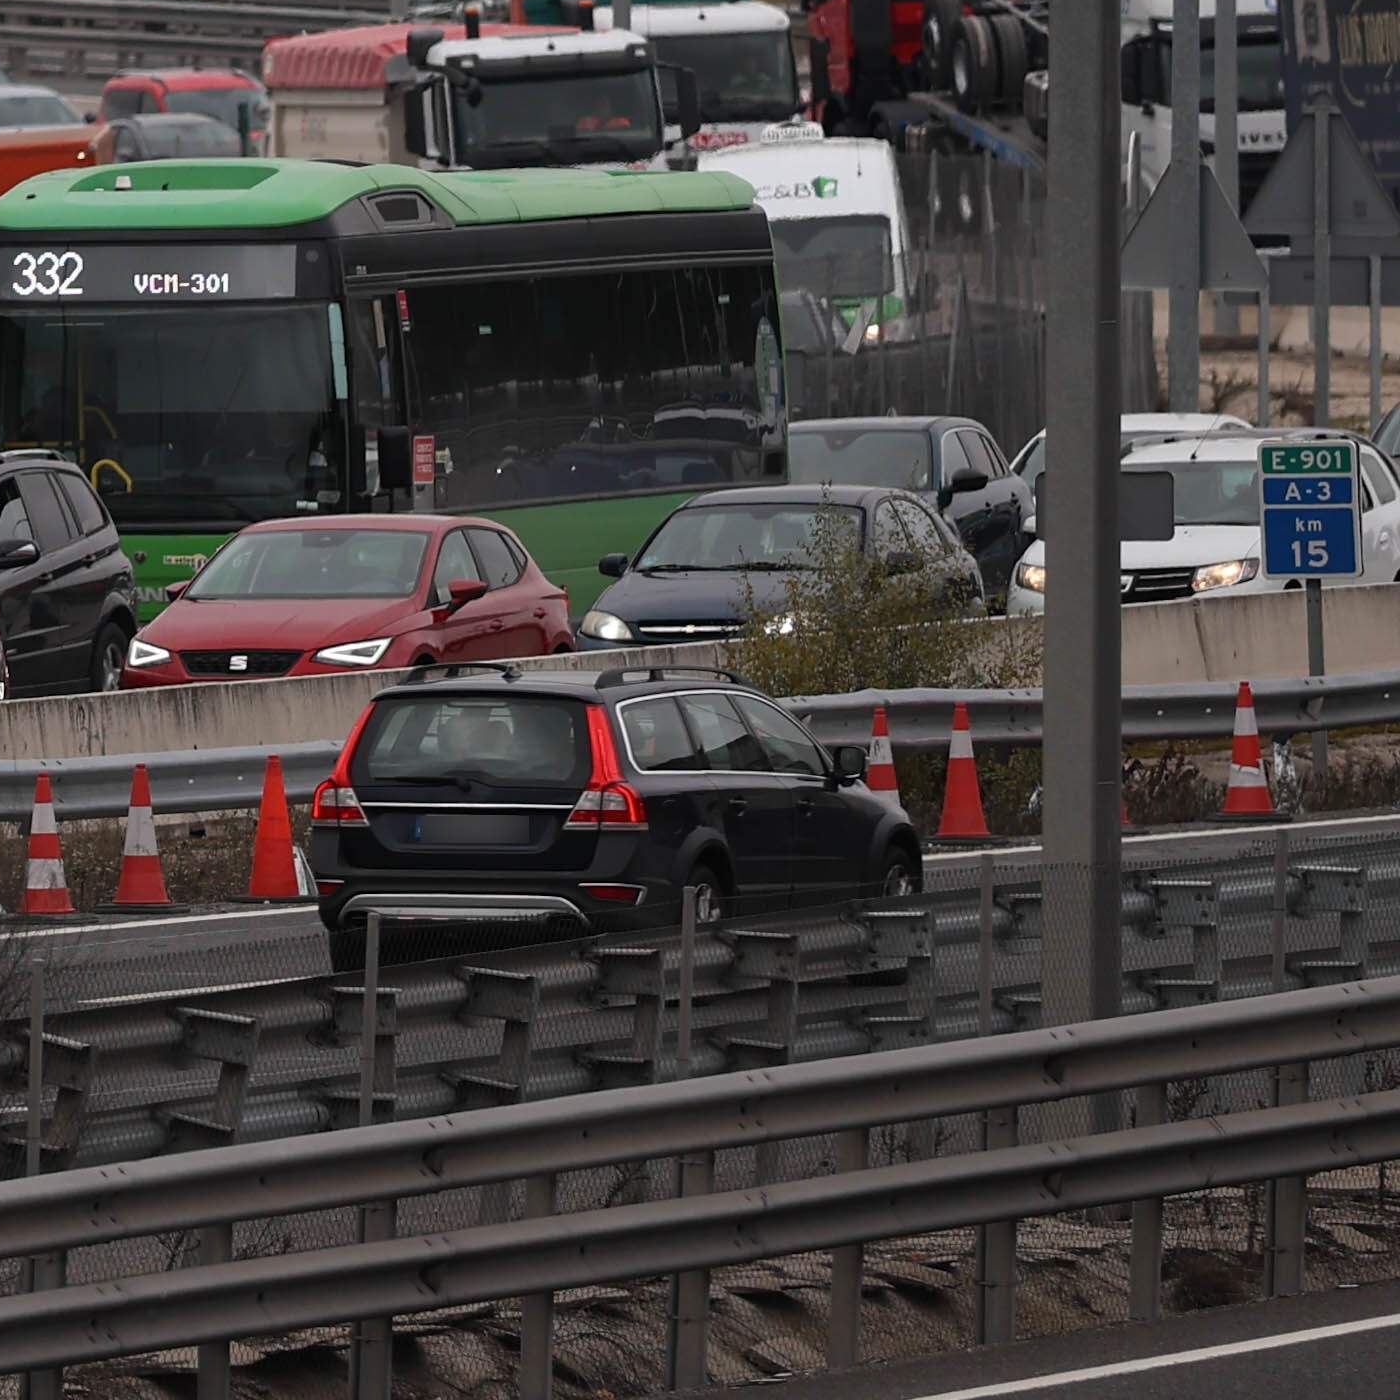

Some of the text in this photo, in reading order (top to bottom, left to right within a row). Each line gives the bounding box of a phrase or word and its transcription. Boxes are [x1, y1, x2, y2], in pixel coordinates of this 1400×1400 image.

[12, 251, 84, 296] 332
[133, 272, 229, 294] VCM-301
[1271, 450, 1342, 471] E-901
[1284, 481, 1332, 501] A-3
[1295, 517, 1323, 532] km
[1291, 539, 1329, 568] 15
